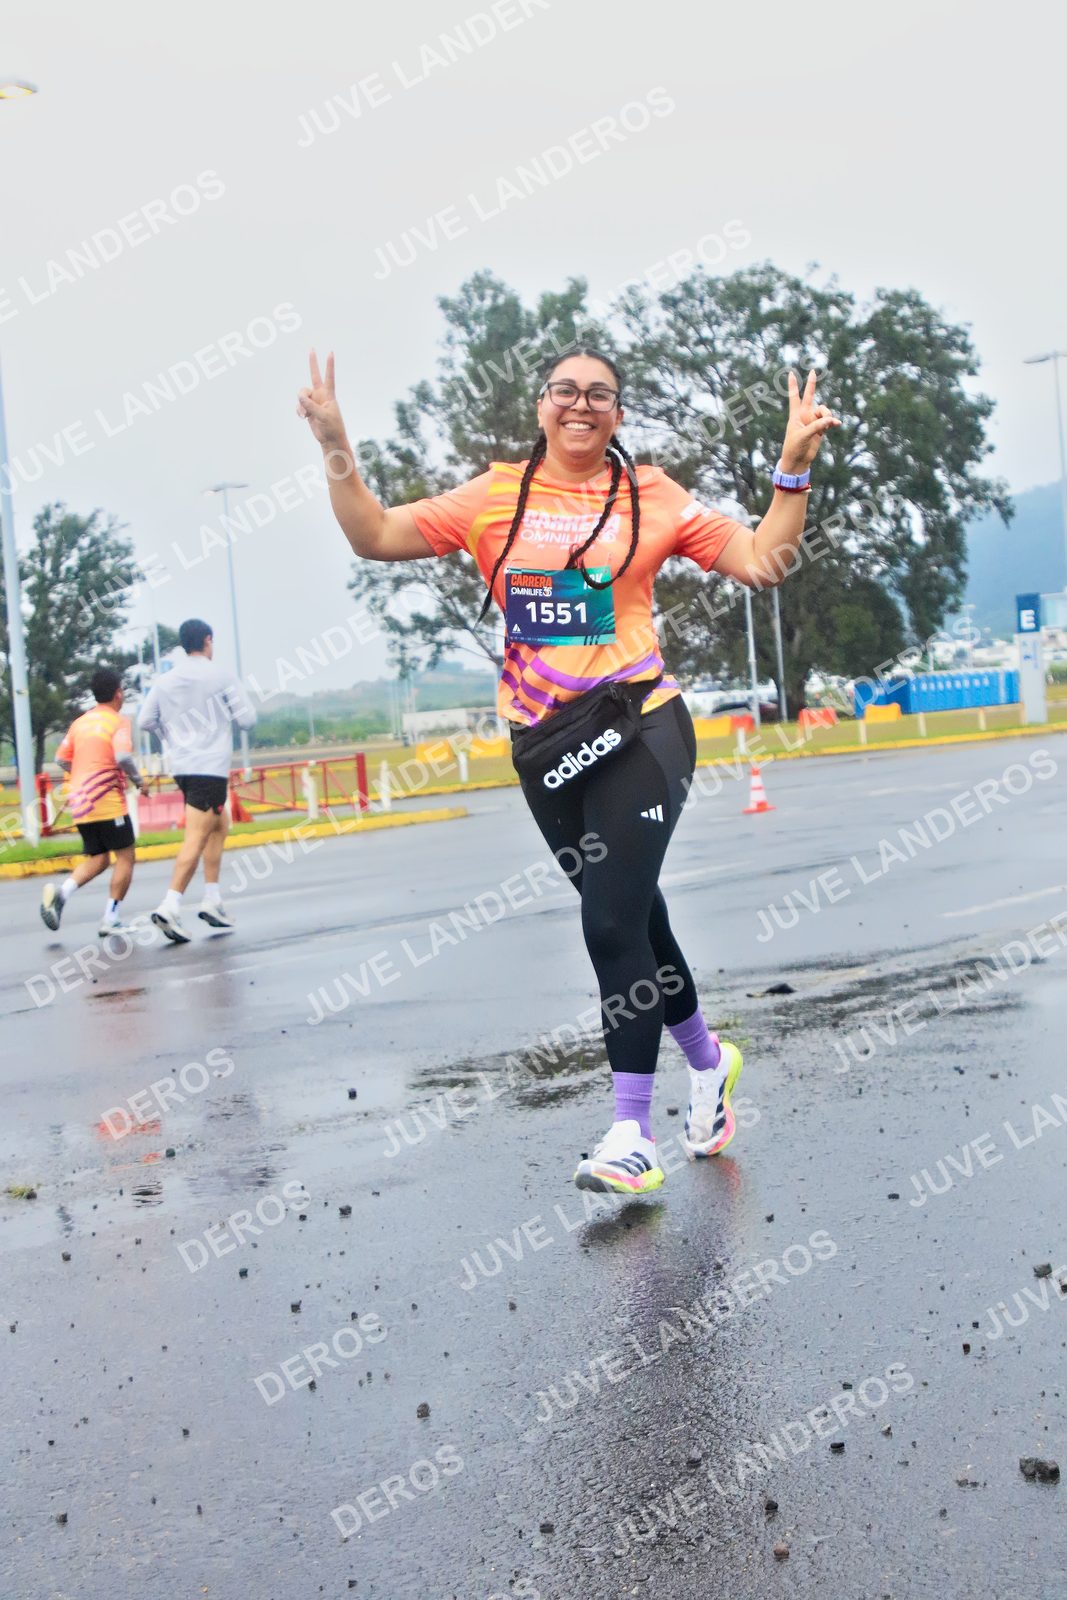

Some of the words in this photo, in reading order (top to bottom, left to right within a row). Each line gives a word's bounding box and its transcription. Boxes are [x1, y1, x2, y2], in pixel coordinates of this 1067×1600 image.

[522, 509, 620, 531] CARREA
[511, 574, 552, 588] CARRERA
[525, 601, 587, 625] 1551
[1021, 609, 1036, 630] E
[543, 728, 622, 789] adidas
